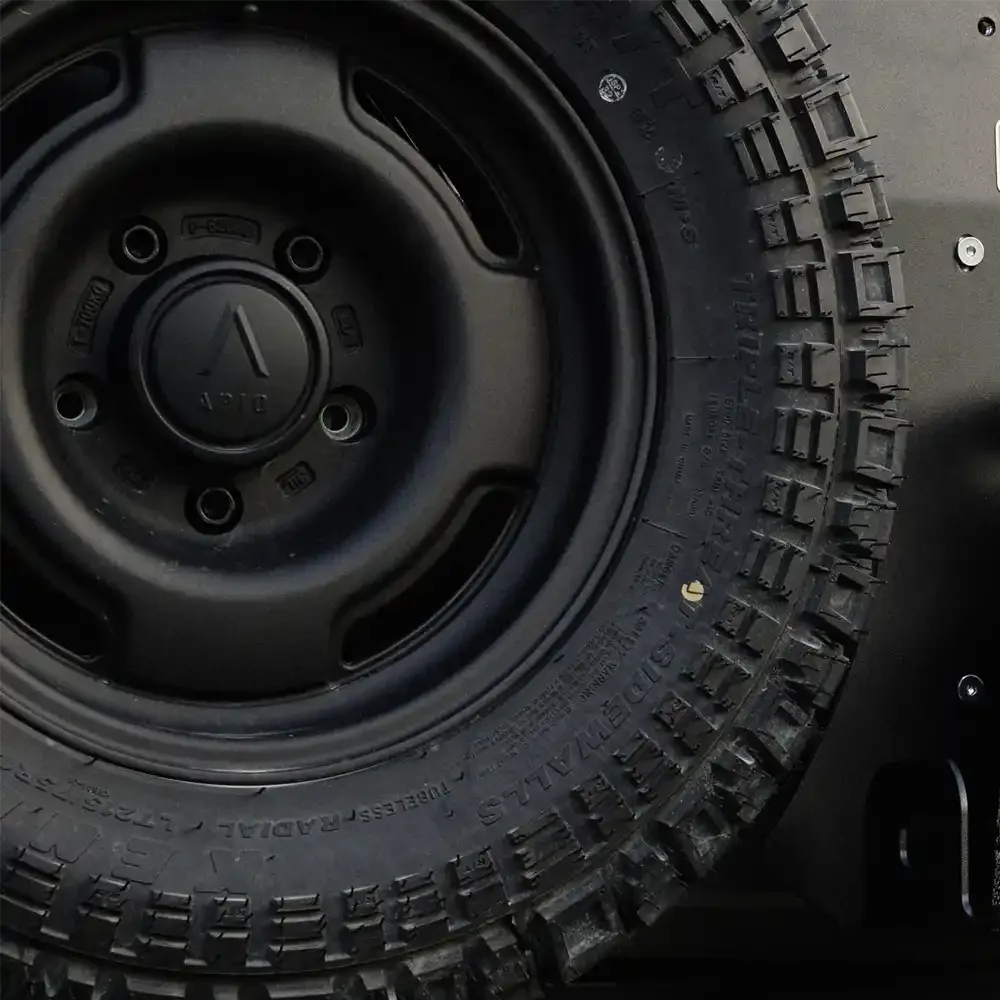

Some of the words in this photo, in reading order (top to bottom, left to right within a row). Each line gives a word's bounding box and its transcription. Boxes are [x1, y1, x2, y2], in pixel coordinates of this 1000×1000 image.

[478, 640, 674, 827] SIDEWALLS
[358, 779, 452, 824] TUBELESS
[218, 810, 340, 839] RADIAL
